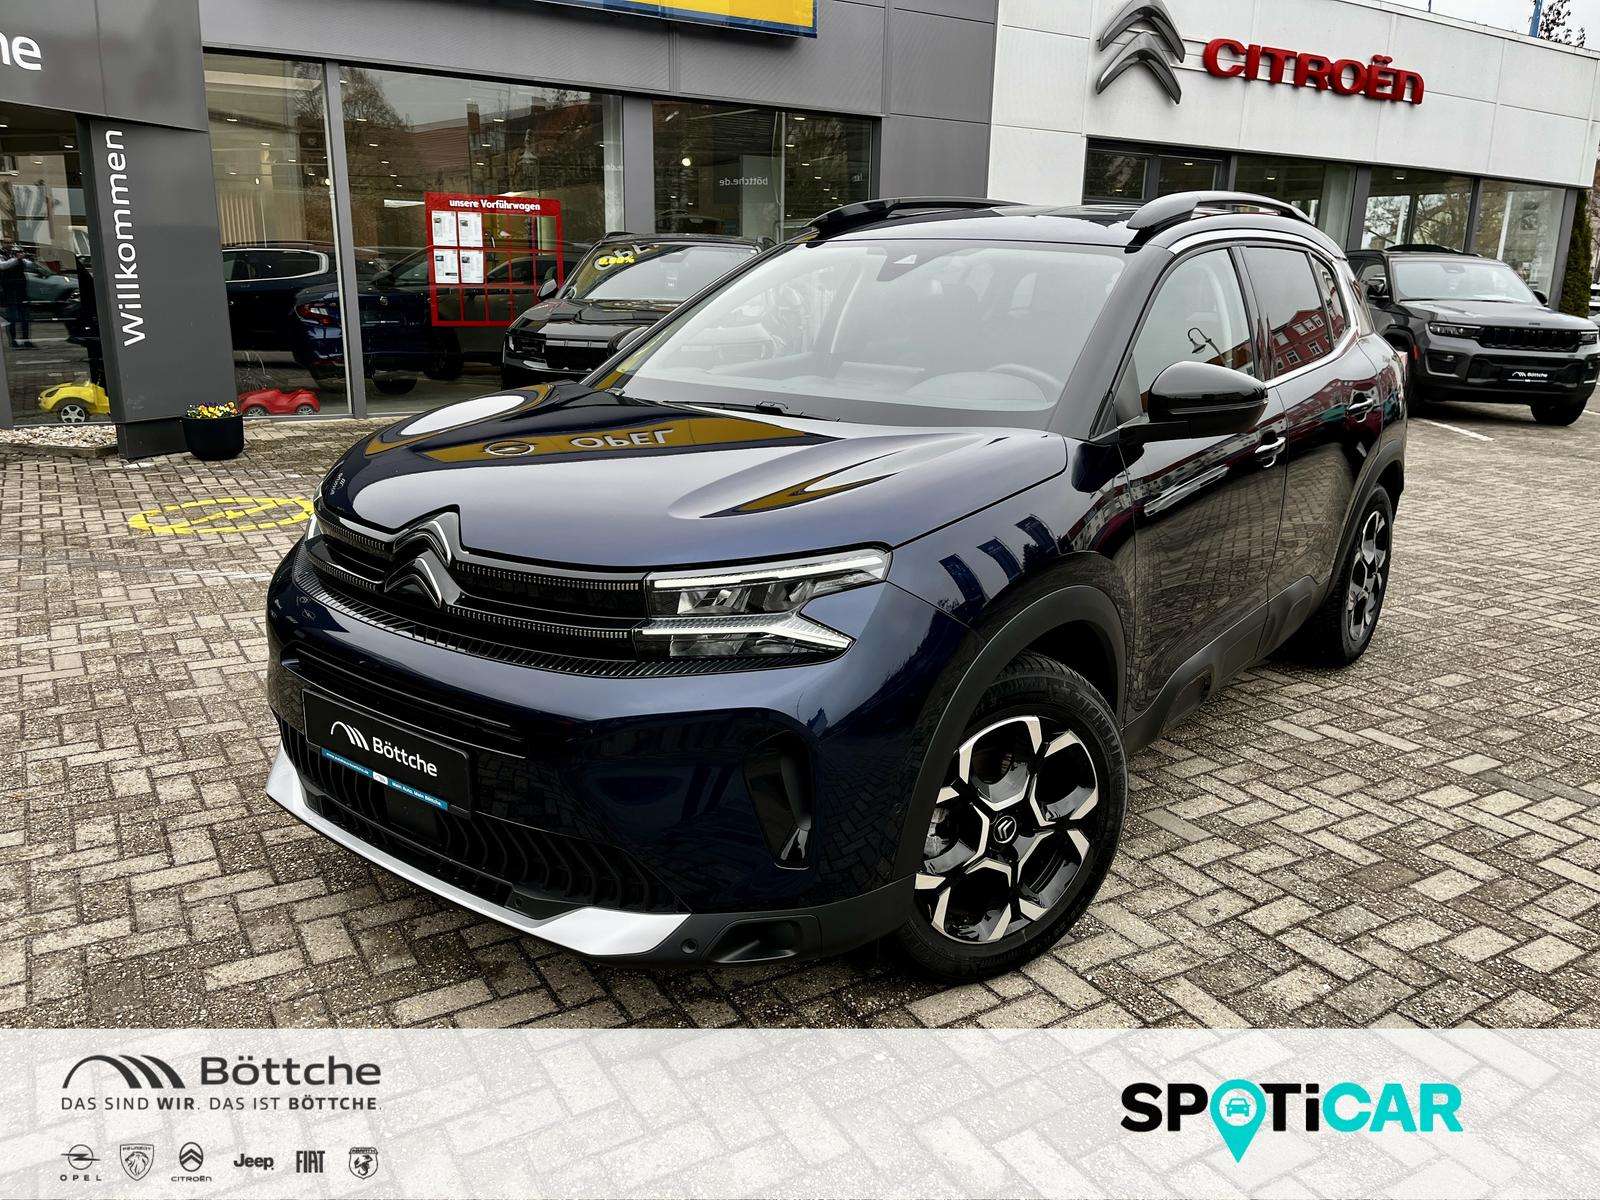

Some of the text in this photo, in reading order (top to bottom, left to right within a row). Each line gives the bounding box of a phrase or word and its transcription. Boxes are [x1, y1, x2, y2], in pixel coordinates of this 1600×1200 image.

[449, 199, 541, 212] unsere Vorführwagen
[105, 129, 146, 347] Willkommen
[372, 736, 438, 777] Böttche
